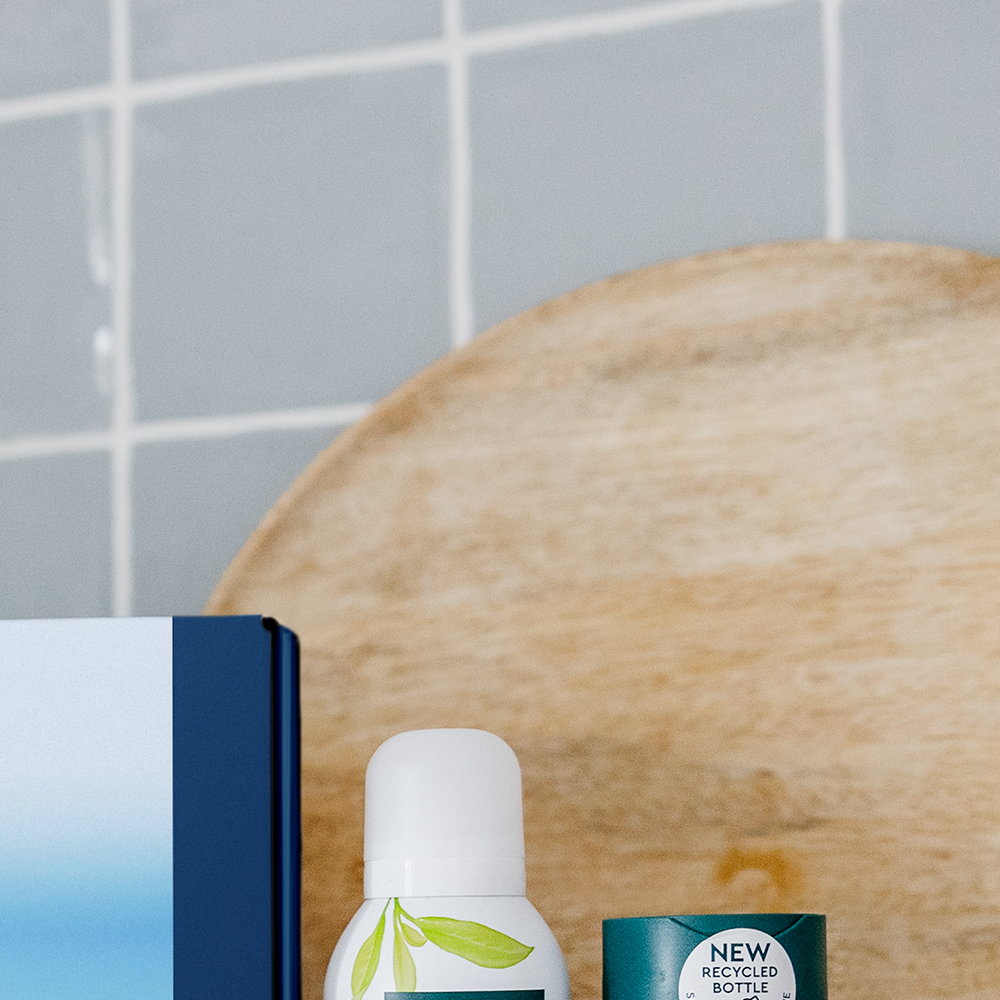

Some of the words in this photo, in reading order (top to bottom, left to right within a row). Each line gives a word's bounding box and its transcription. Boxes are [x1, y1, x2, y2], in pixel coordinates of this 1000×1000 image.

[710, 943, 771, 962] NEW
[702, 966, 778, 978] RECYCLED
[713, 982, 769, 994] BOTTLE
